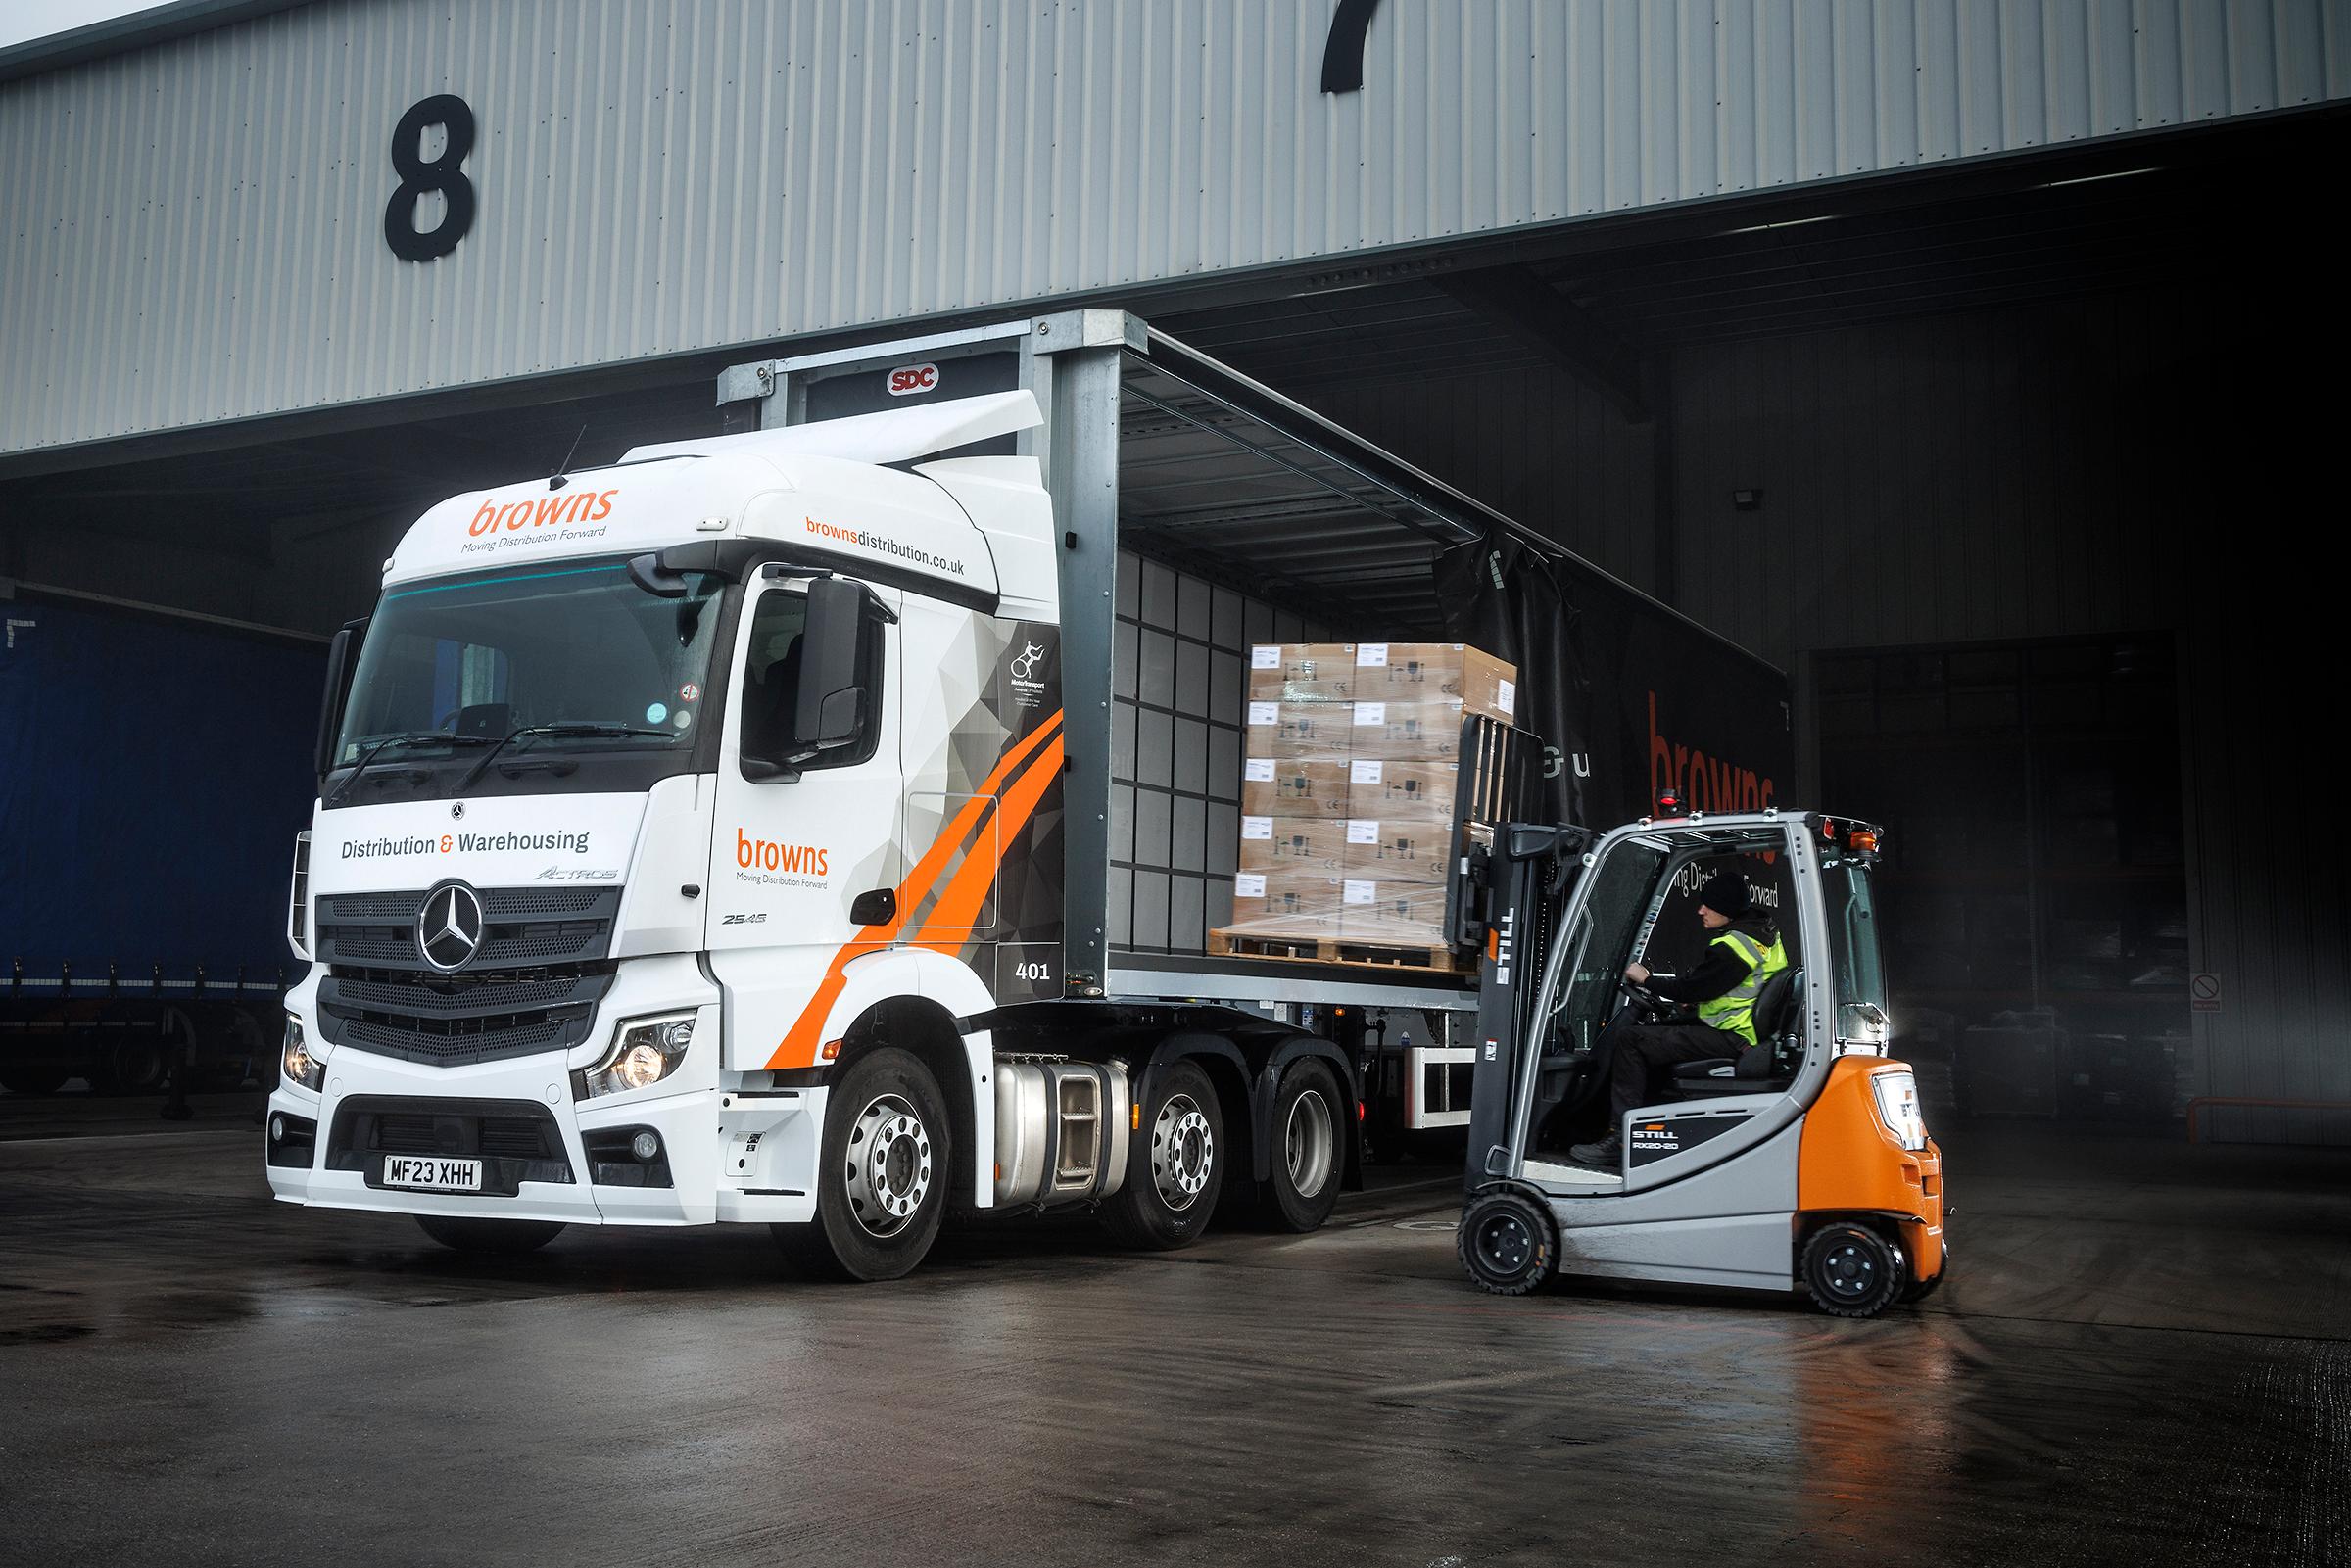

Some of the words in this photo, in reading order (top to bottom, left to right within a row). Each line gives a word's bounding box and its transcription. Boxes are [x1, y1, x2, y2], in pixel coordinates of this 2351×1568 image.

[385, 94, 475, 263] 8
[892, 367, 935, 391] SDC
[469, 490, 619, 537] browns
[461, 541, 497, 554] Moving
[499, 532, 557, 548] Distribution
[559, 526, 607, 541] Forward
[806, 516, 965, 576] brownsdistribution.co.uk
[1648, 689, 1775, 864] browns
[342, 835, 435, 859] Distribution
[440, 834, 454, 853] &
[458, 830, 590, 854] Warehousing
[737, 828, 828, 877] browns
[737, 872, 761, 885] Moving
[763, 875, 800, 887] Distribution
[801, 878, 828, 889] Forward
[1496, 907, 1515, 985] STILL
[1015, 962, 1050, 980] 401
[1632, 1130, 1679, 1139] STILL
[391, 1159, 434, 1183] MF23
[439, 1162, 474, 1185] XHH
